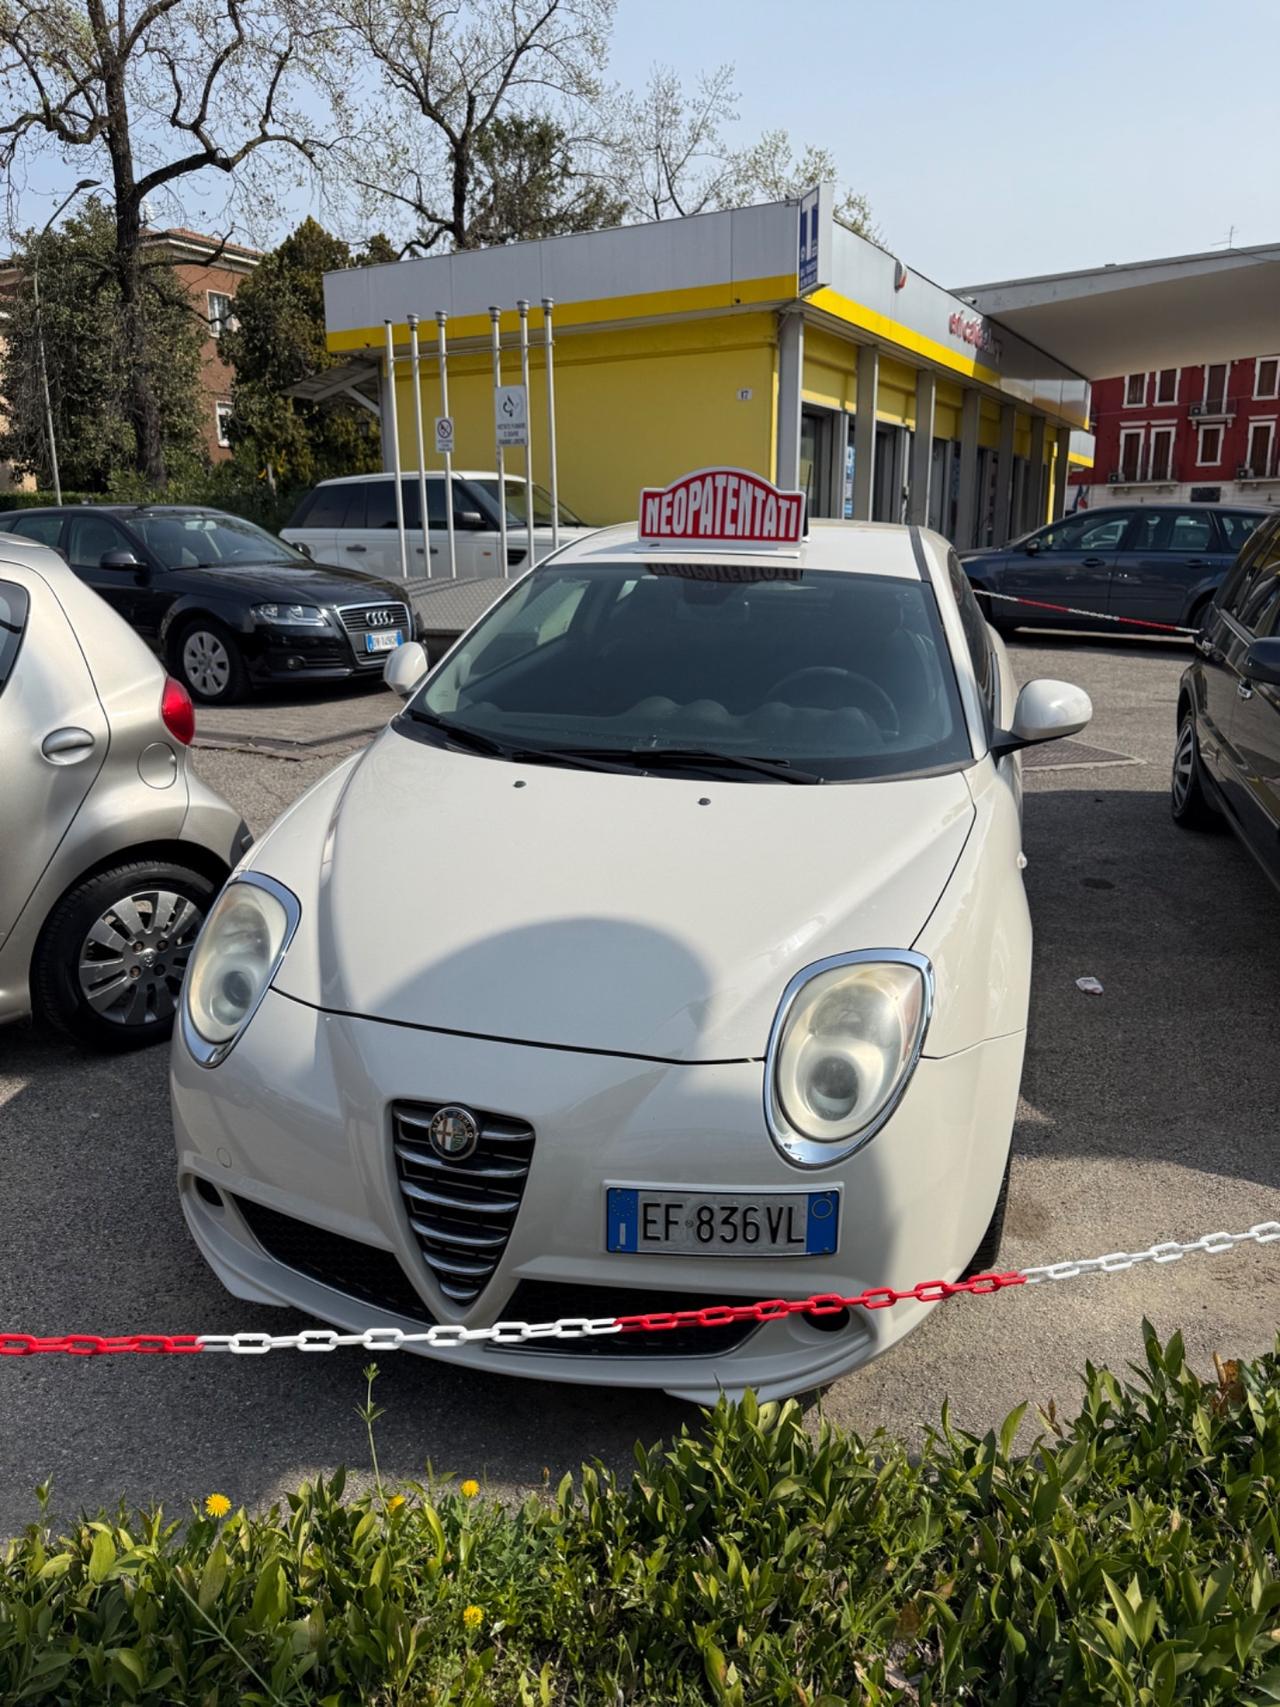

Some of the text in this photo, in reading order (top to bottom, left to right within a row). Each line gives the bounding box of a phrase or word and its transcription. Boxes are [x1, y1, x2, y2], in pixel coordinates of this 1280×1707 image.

[645, 474, 798, 538] NEOPATENTATI
[642, 1203, 683, 1241] EF
[697, 1205, 804, 1244] 836VL
